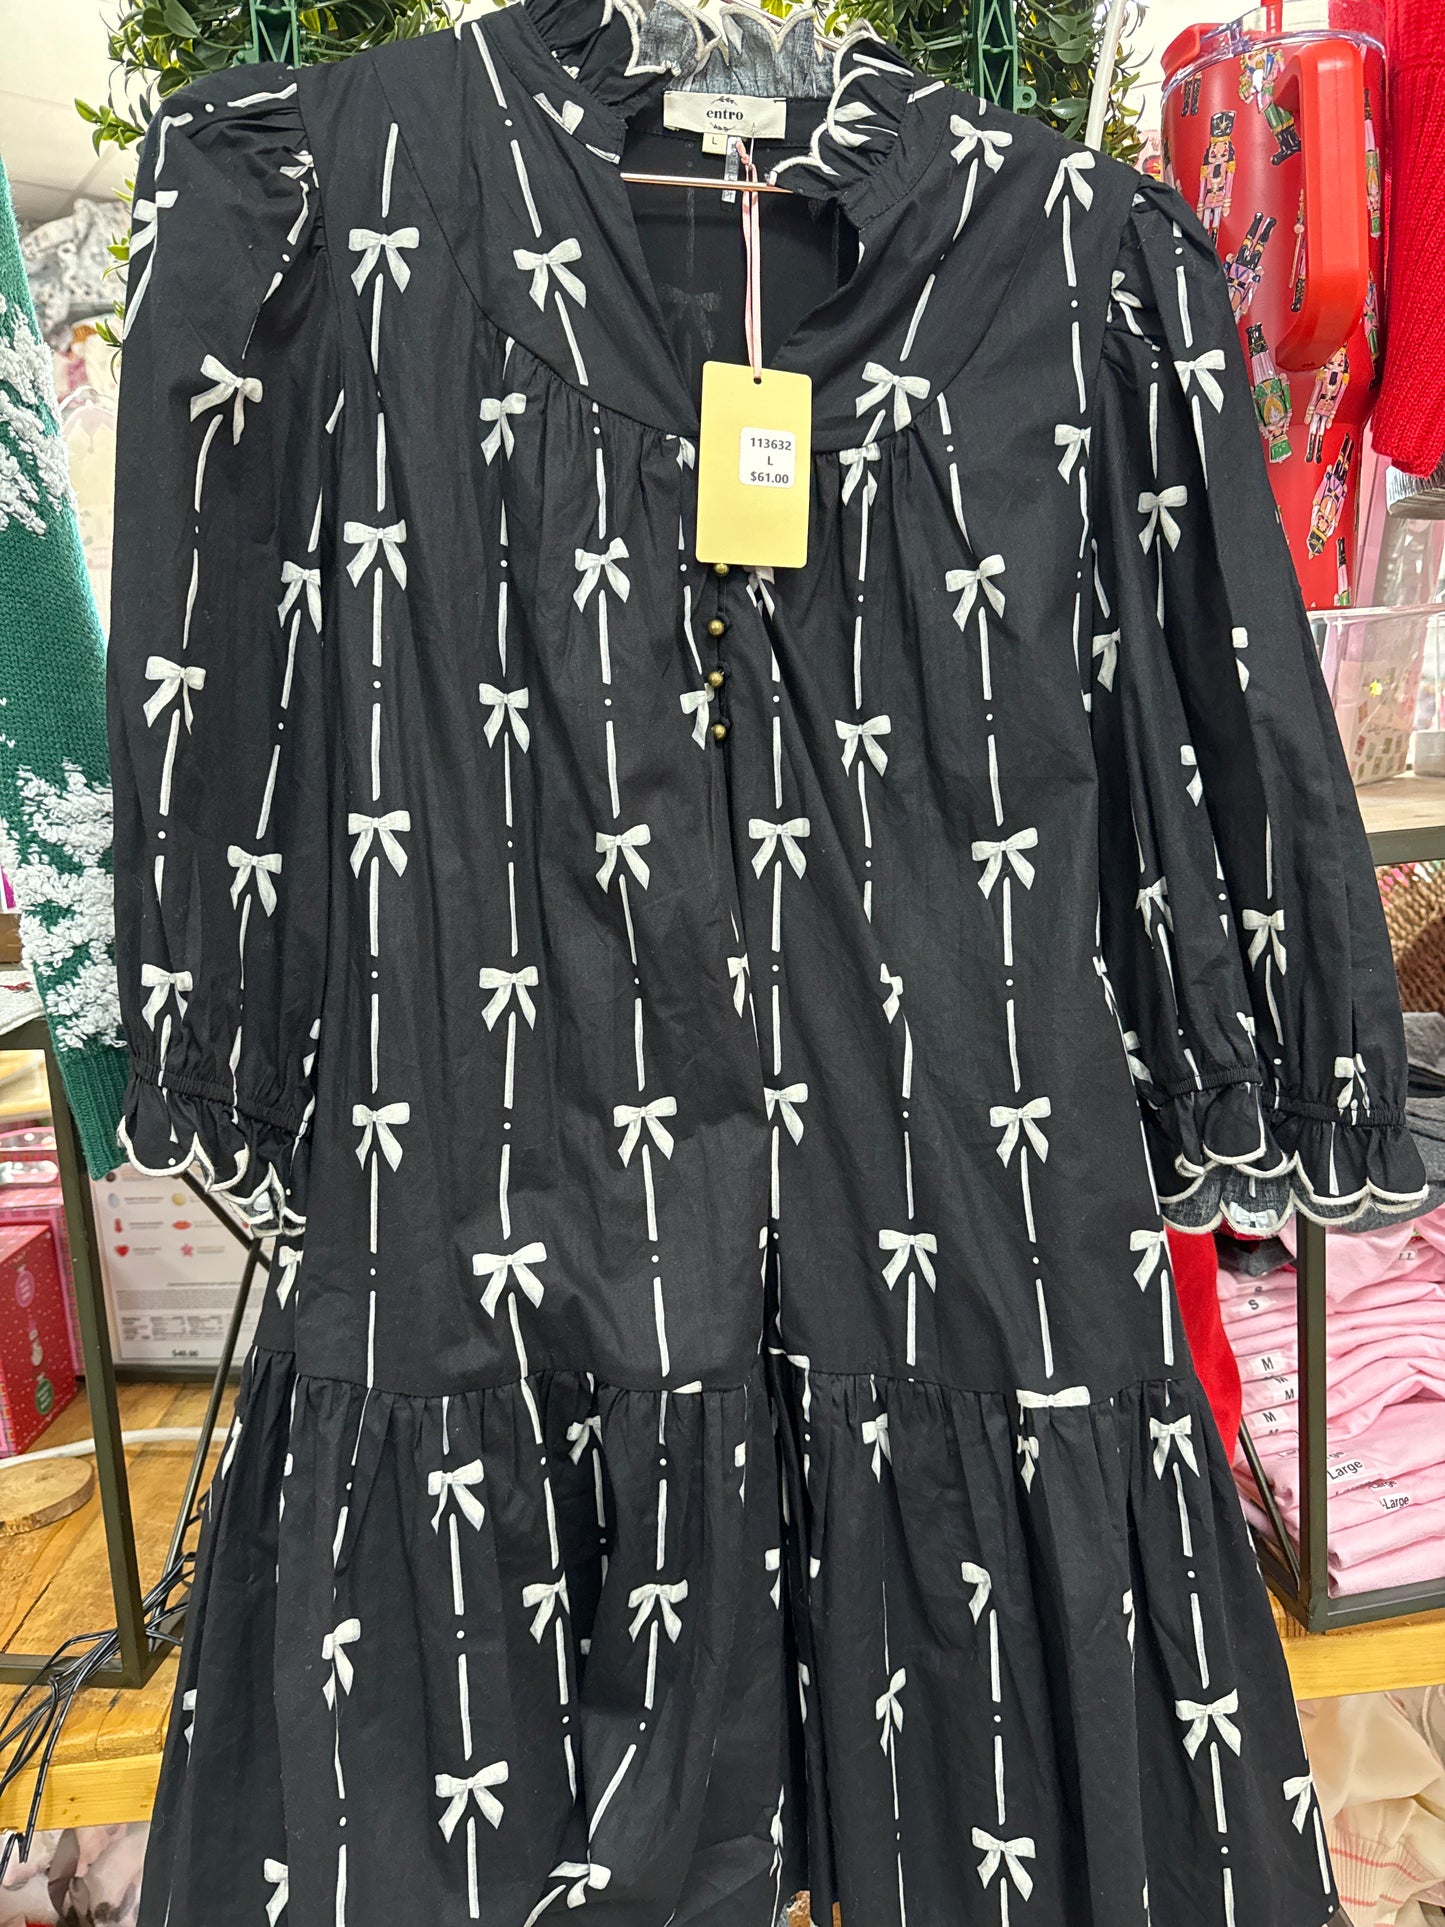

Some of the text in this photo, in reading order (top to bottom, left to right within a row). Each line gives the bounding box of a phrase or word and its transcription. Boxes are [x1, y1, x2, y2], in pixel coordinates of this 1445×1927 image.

[706, 109, 744, 121] entro
[711, 136, 718, 145] L
[750, 437, 792, 451] 113632
[767, 456, 774, 466] L
[750, 471, 789, 484] $61.00
[1248, 1299, 1260, 1310] S
[1261, 1357, 1275, 1371] M
[1284, 1388, 1295, 1401] M
[1262, 1411, 1277, 1423] M
